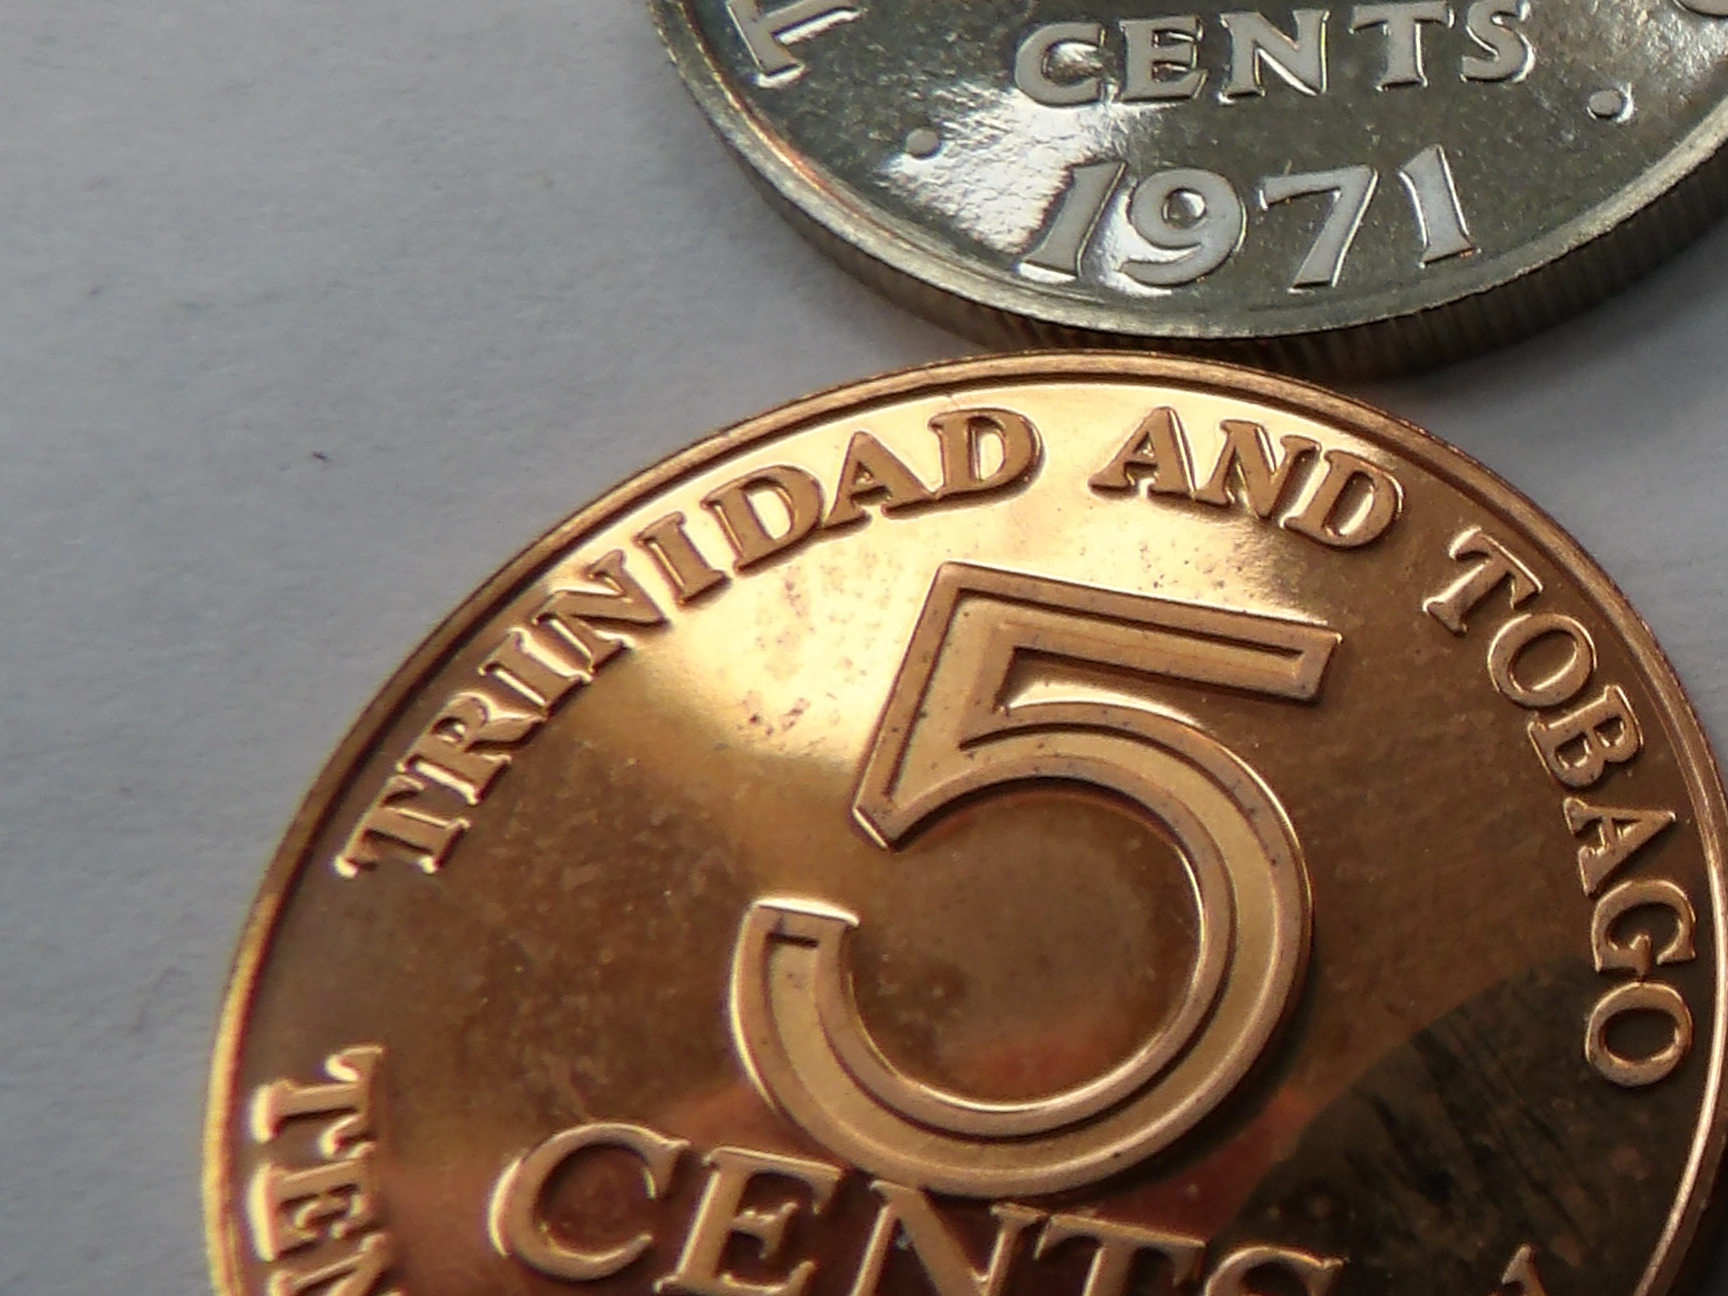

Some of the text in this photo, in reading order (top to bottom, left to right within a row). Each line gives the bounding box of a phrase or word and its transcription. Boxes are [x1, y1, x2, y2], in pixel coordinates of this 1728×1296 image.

[1016, 143, 1480, 296] 1971
[332, 404, 1701, 1092] TRINIDAD AND TOBAGO
[730, 562, 1342, 1199] 5
